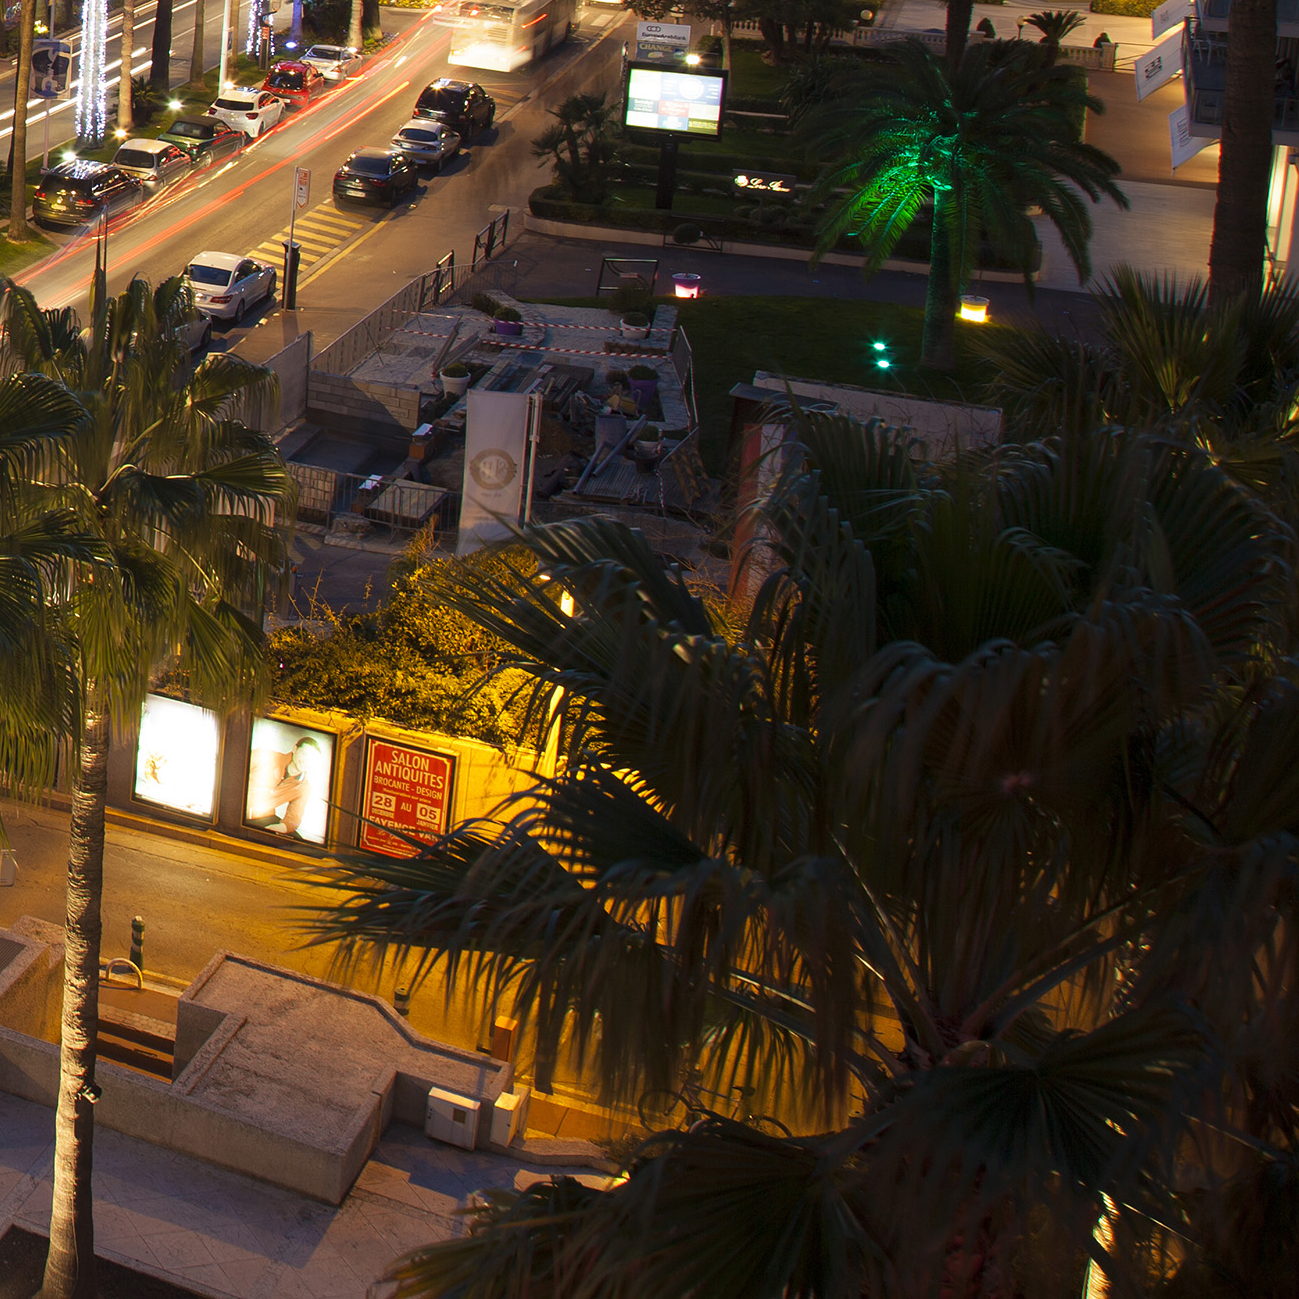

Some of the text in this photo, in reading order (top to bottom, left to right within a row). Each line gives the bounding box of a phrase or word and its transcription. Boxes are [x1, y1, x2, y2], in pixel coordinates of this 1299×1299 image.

[639, 43, 673, 51] CHANGE
[391, 750, 429, 771] SALON
[373, 775, 410, 792] BROCANTE
[416, 786, 443, 800] DESIGN
[375, 761, 443, 789] ANTIQUITES
[373, 795, 437, 821] 28 AU 05
